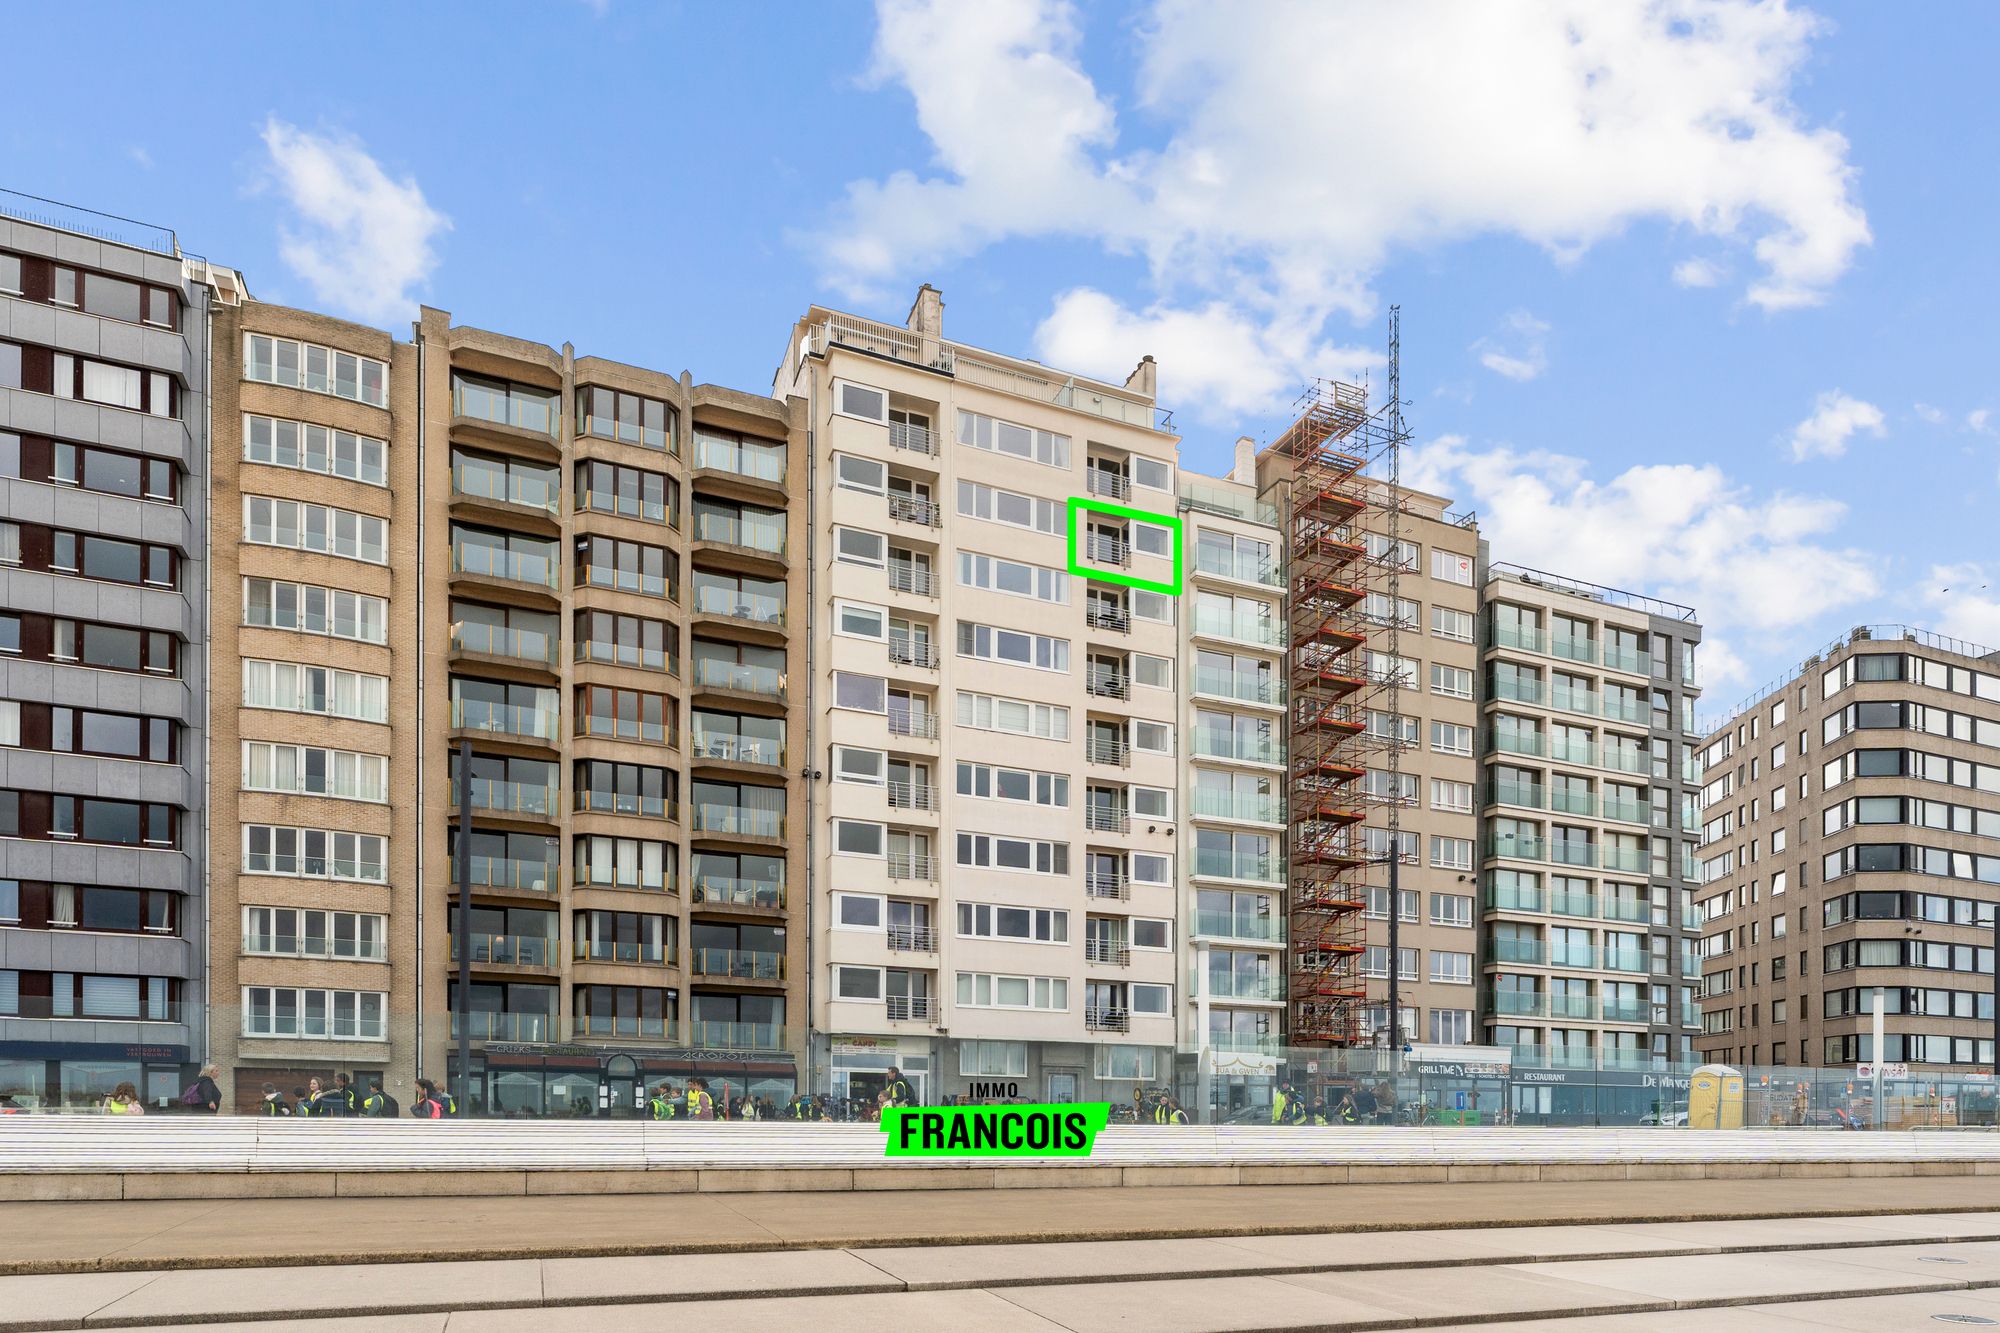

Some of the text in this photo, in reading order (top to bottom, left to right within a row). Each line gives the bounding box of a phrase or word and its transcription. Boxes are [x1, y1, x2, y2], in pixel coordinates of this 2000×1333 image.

[680, 1051, 756, 1061] ACROPOLIS
[1418, 1064, 1455, 1075] GRILL TIME
[1524, 1073, 1565, 1081] RESTAURANT
